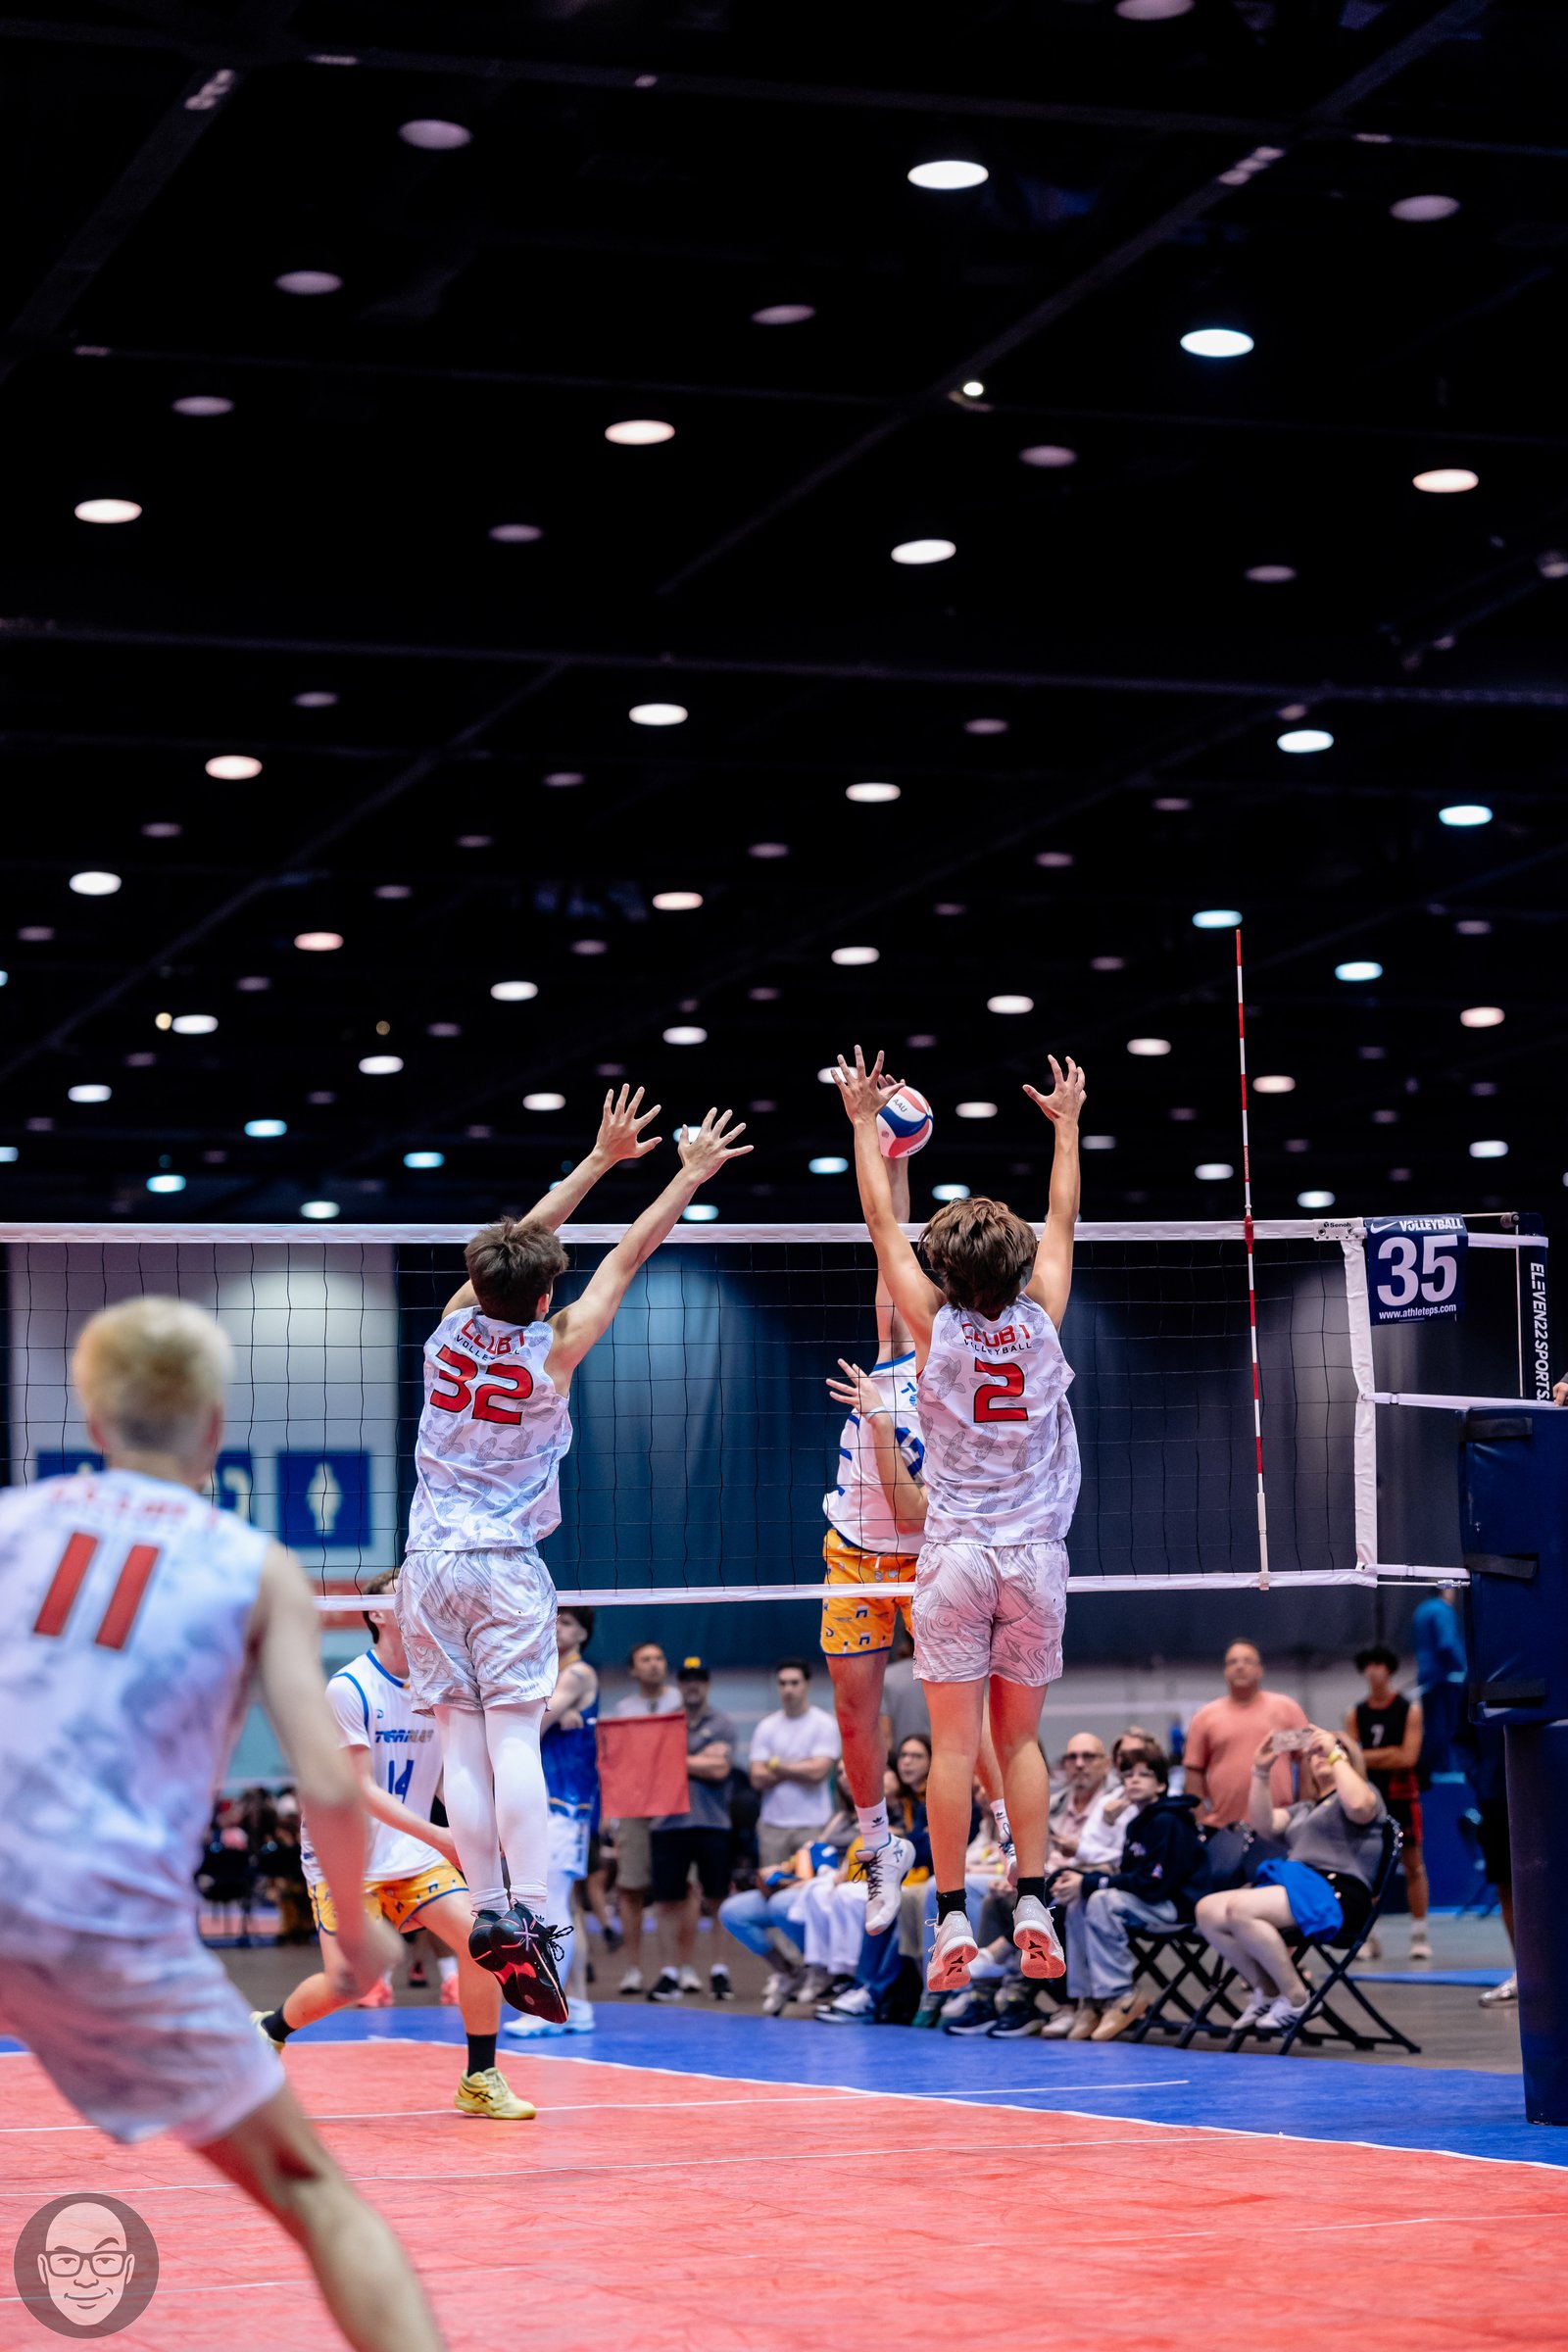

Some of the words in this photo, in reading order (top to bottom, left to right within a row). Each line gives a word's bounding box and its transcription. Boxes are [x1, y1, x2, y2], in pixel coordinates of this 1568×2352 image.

[893, 1098, 908, 1112] AAU
[1399, 1218, 1463, 1232] VOLLEYBALL
[1377, 1234, 1458, 1306] 35
[1379, 1304, 1457, 1319] www.athleteps.com
[430, 1344, 534, 1426] 32
[974, 1356, 1029, 1423] 2
[33, 1532, 160, 1650] 11
[388, 1759, 414, 1803] 14
